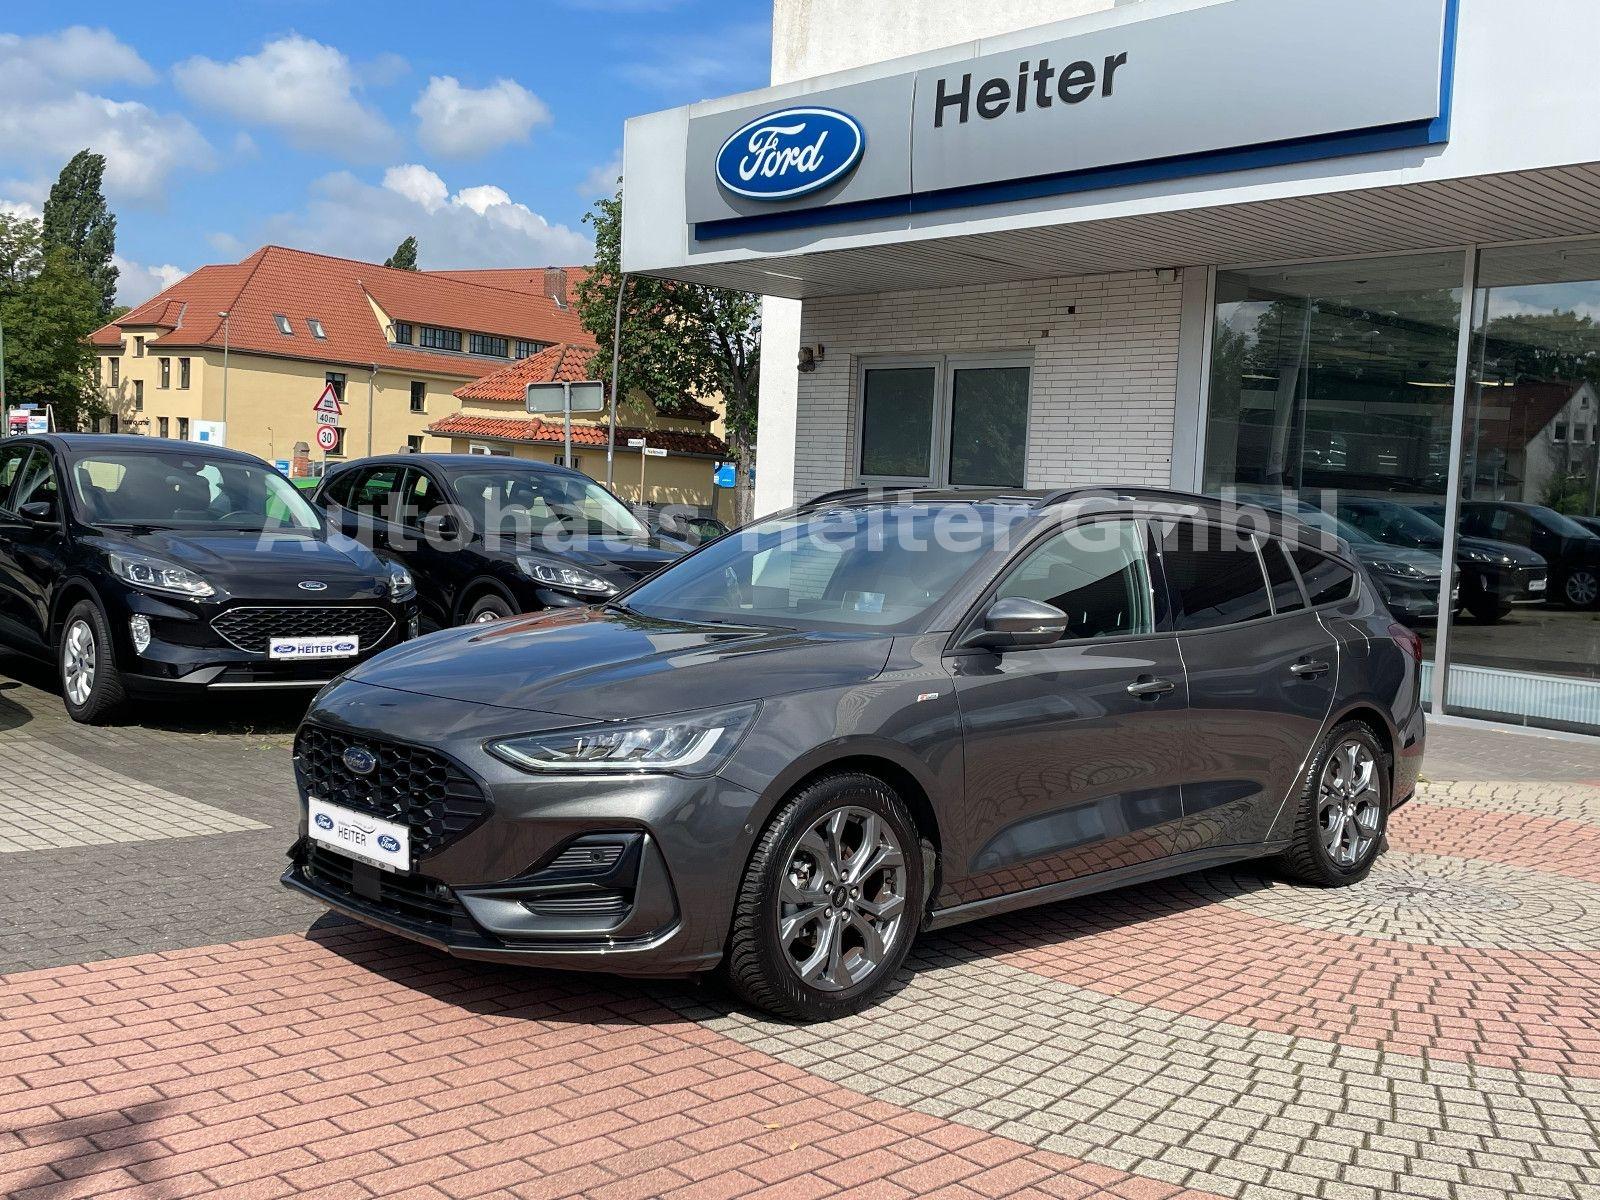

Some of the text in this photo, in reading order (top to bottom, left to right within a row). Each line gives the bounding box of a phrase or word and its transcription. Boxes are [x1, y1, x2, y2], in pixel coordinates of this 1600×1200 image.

[934, 51, 1128, 128] Heiter
[739, 122, 828, 181] Ford
[321, 431, 332, 444] 30
[297, 645, 333, 654] HEITER
[338, 826, 367, 847] HEITER
